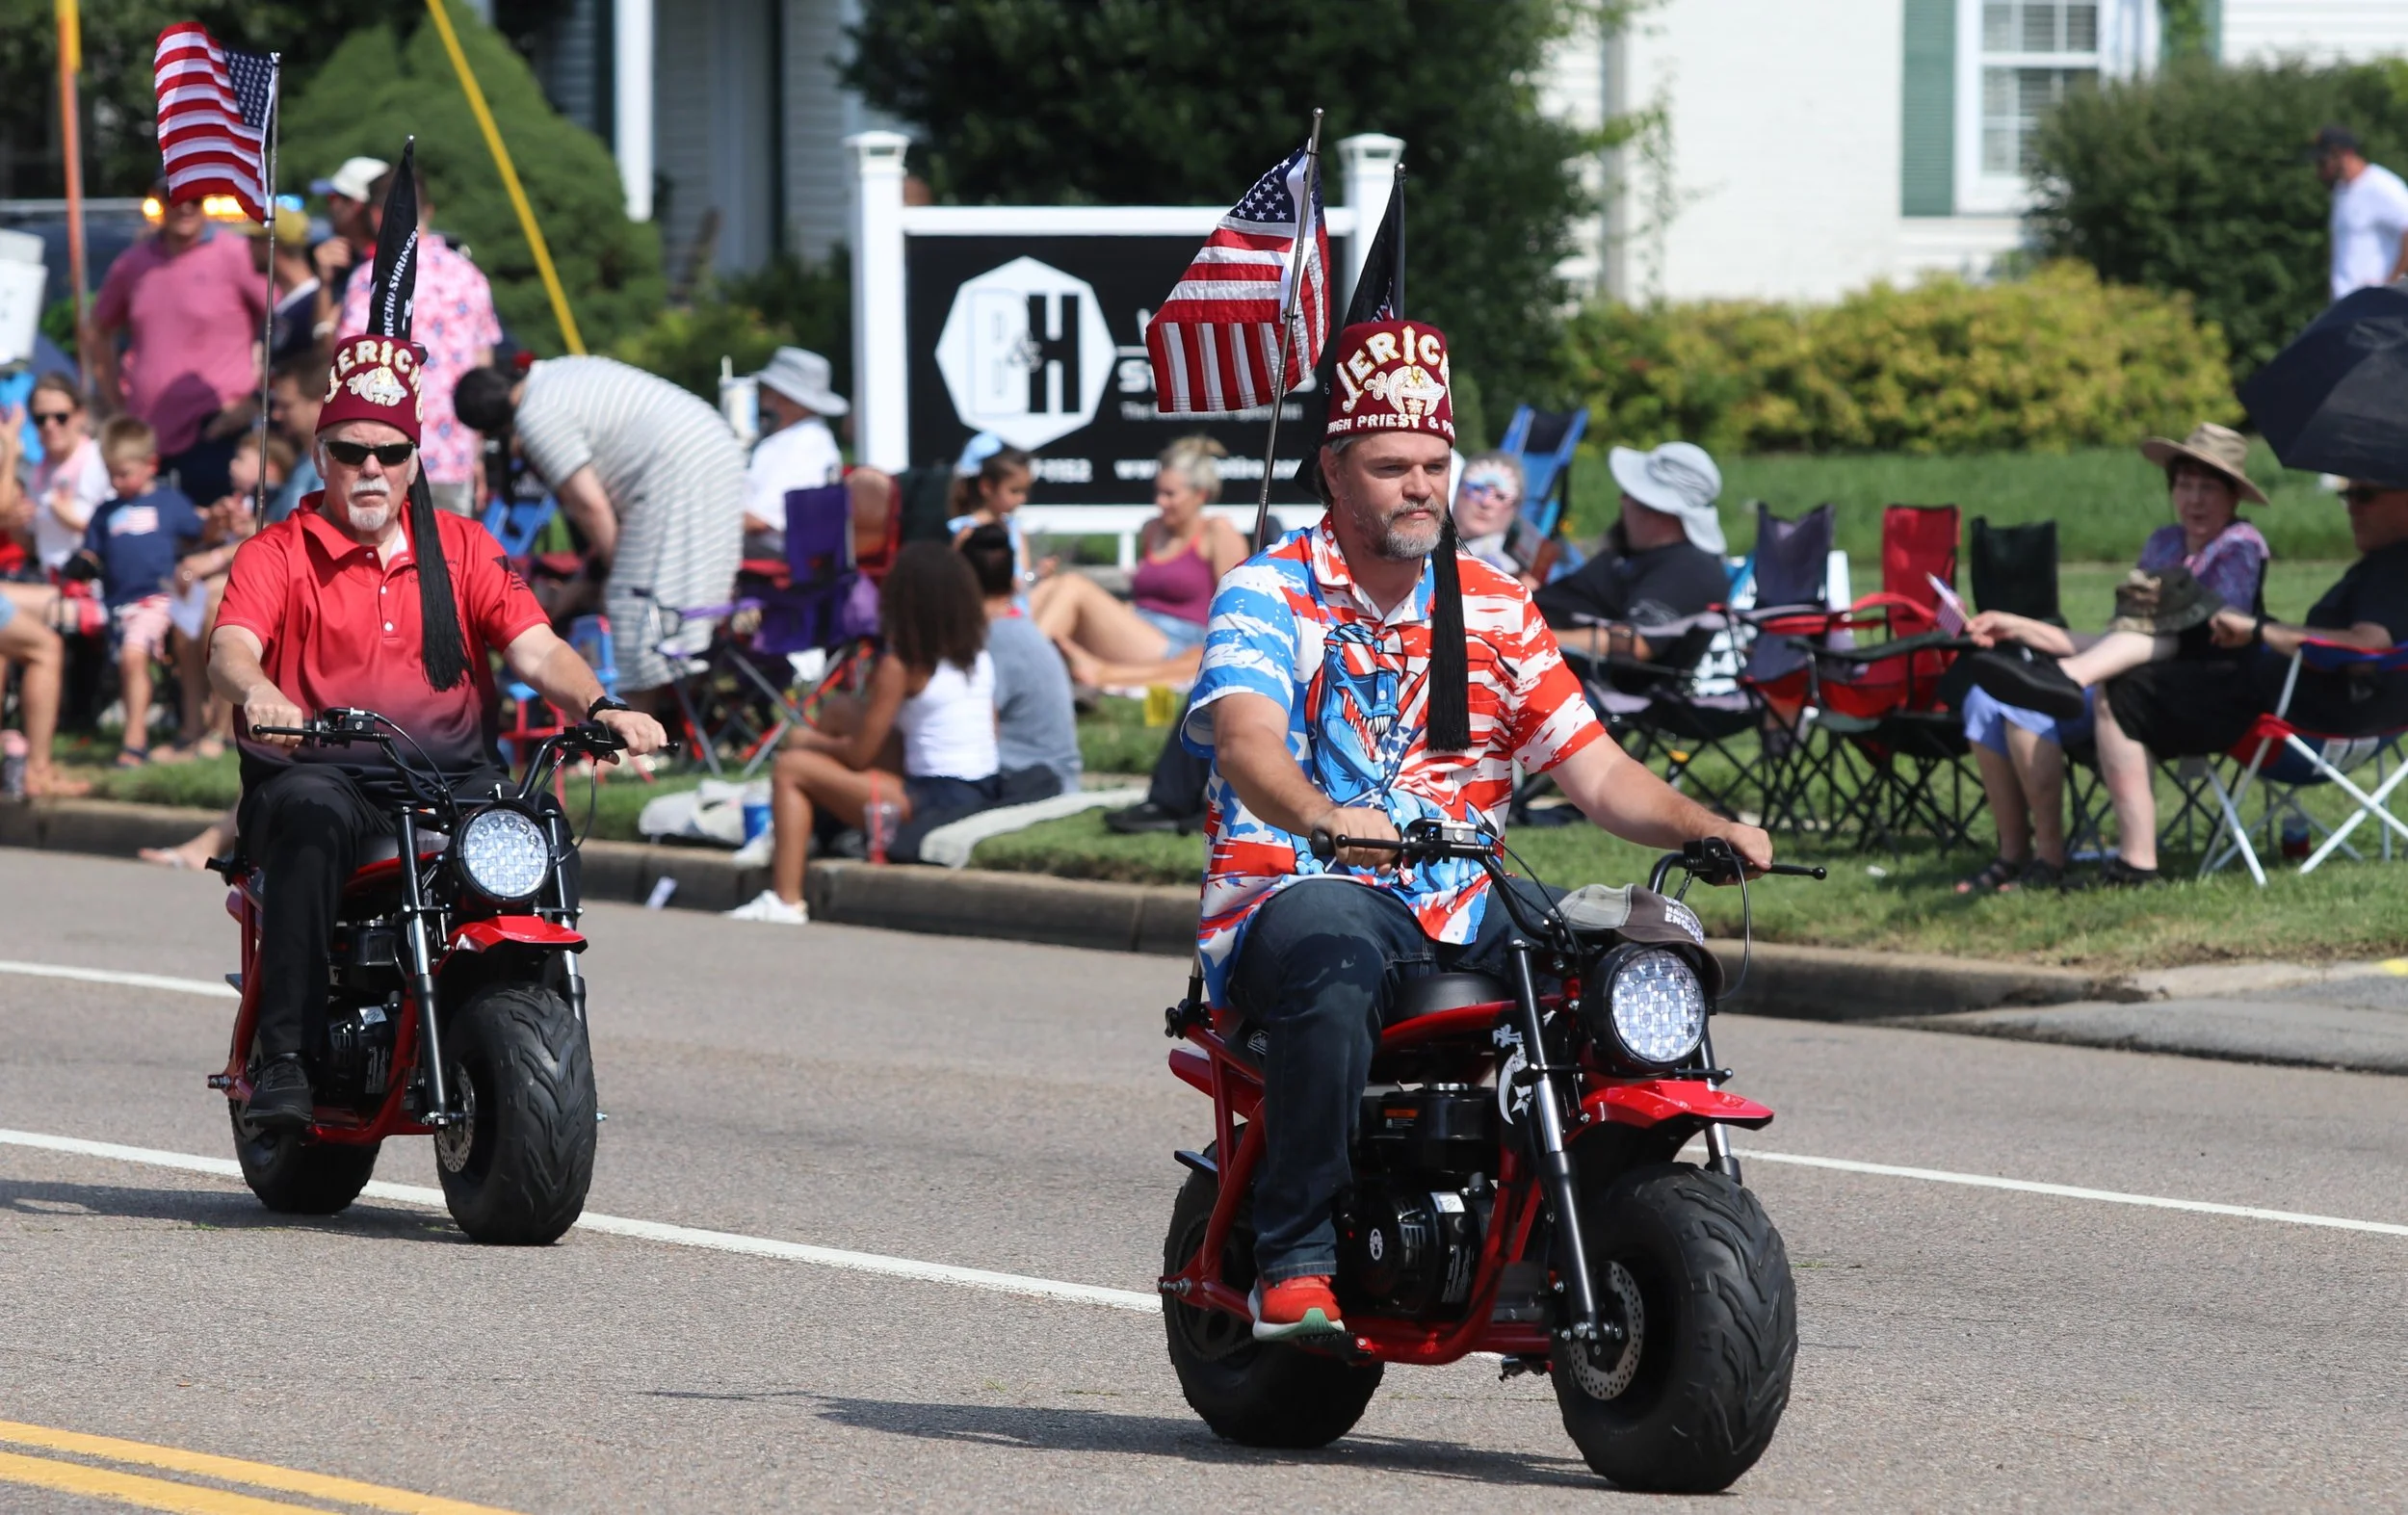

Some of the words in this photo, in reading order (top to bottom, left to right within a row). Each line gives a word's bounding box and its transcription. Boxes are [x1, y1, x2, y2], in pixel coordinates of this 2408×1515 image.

[388, 225, 418, 291] SHRINER
[1356, 413, 1421, 429] PRIEST
[1427, 416, 1439, 430] &
